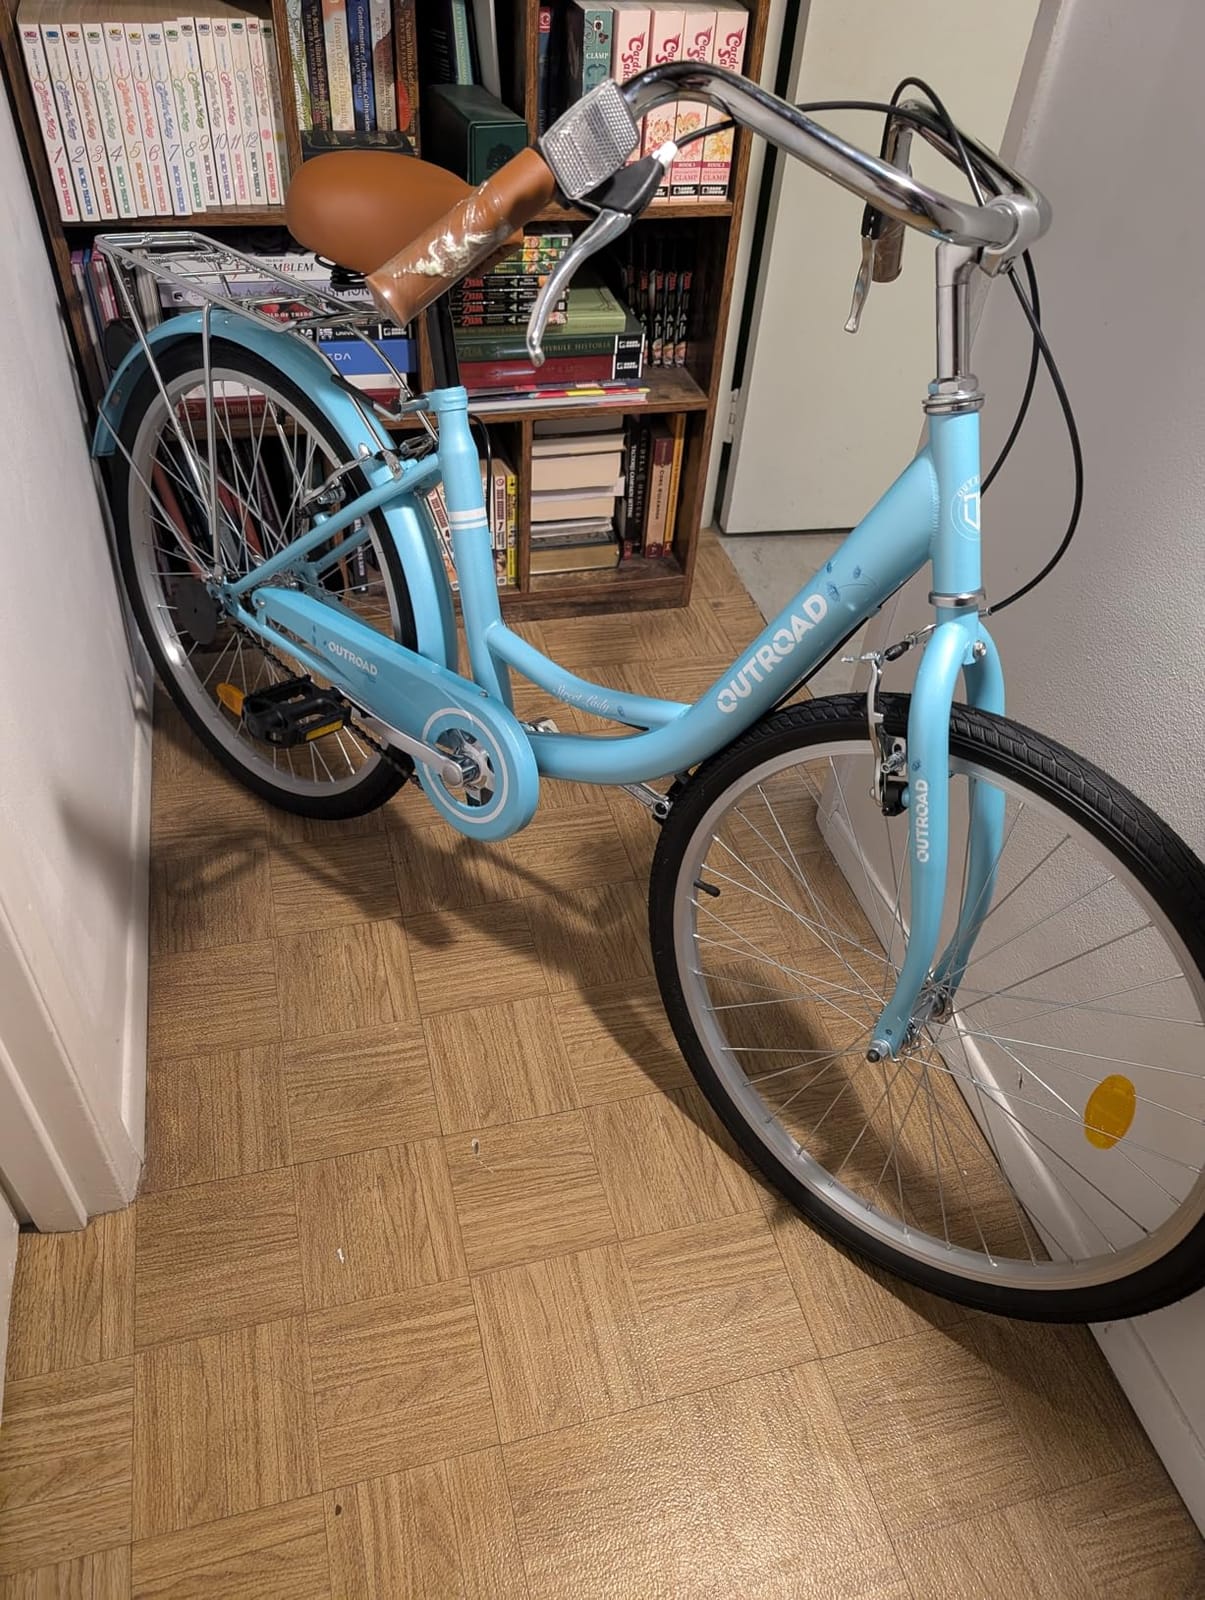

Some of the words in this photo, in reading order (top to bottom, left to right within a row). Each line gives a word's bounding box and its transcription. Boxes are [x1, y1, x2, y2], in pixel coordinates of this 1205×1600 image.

[586, 52, 609, 60] CLAMP
[198, 135, 209, 151] 9
[214, 133, 228, 149] 10
[229, 133, 242, 150] 11
[245, 132, 259, 148] 12
[53, 147, 63, 164] 1
[71, 147, 85, 163] 2
[90, 145, 103, 162] 3
[110, 146, 123, 162] 4
[129, 141, 143, 158] 5
[150, 145, 160, 161] 6
[167, 145, 180, 161] 7
[185, 142, 196, 157] 8
[266, 263, 314, 272] MBLEM
[328, 641, 378, 676] OUTROAD
[715, 593, 828, 714] OUTROAD
[916, 779, 929, 863] OUTROAD
